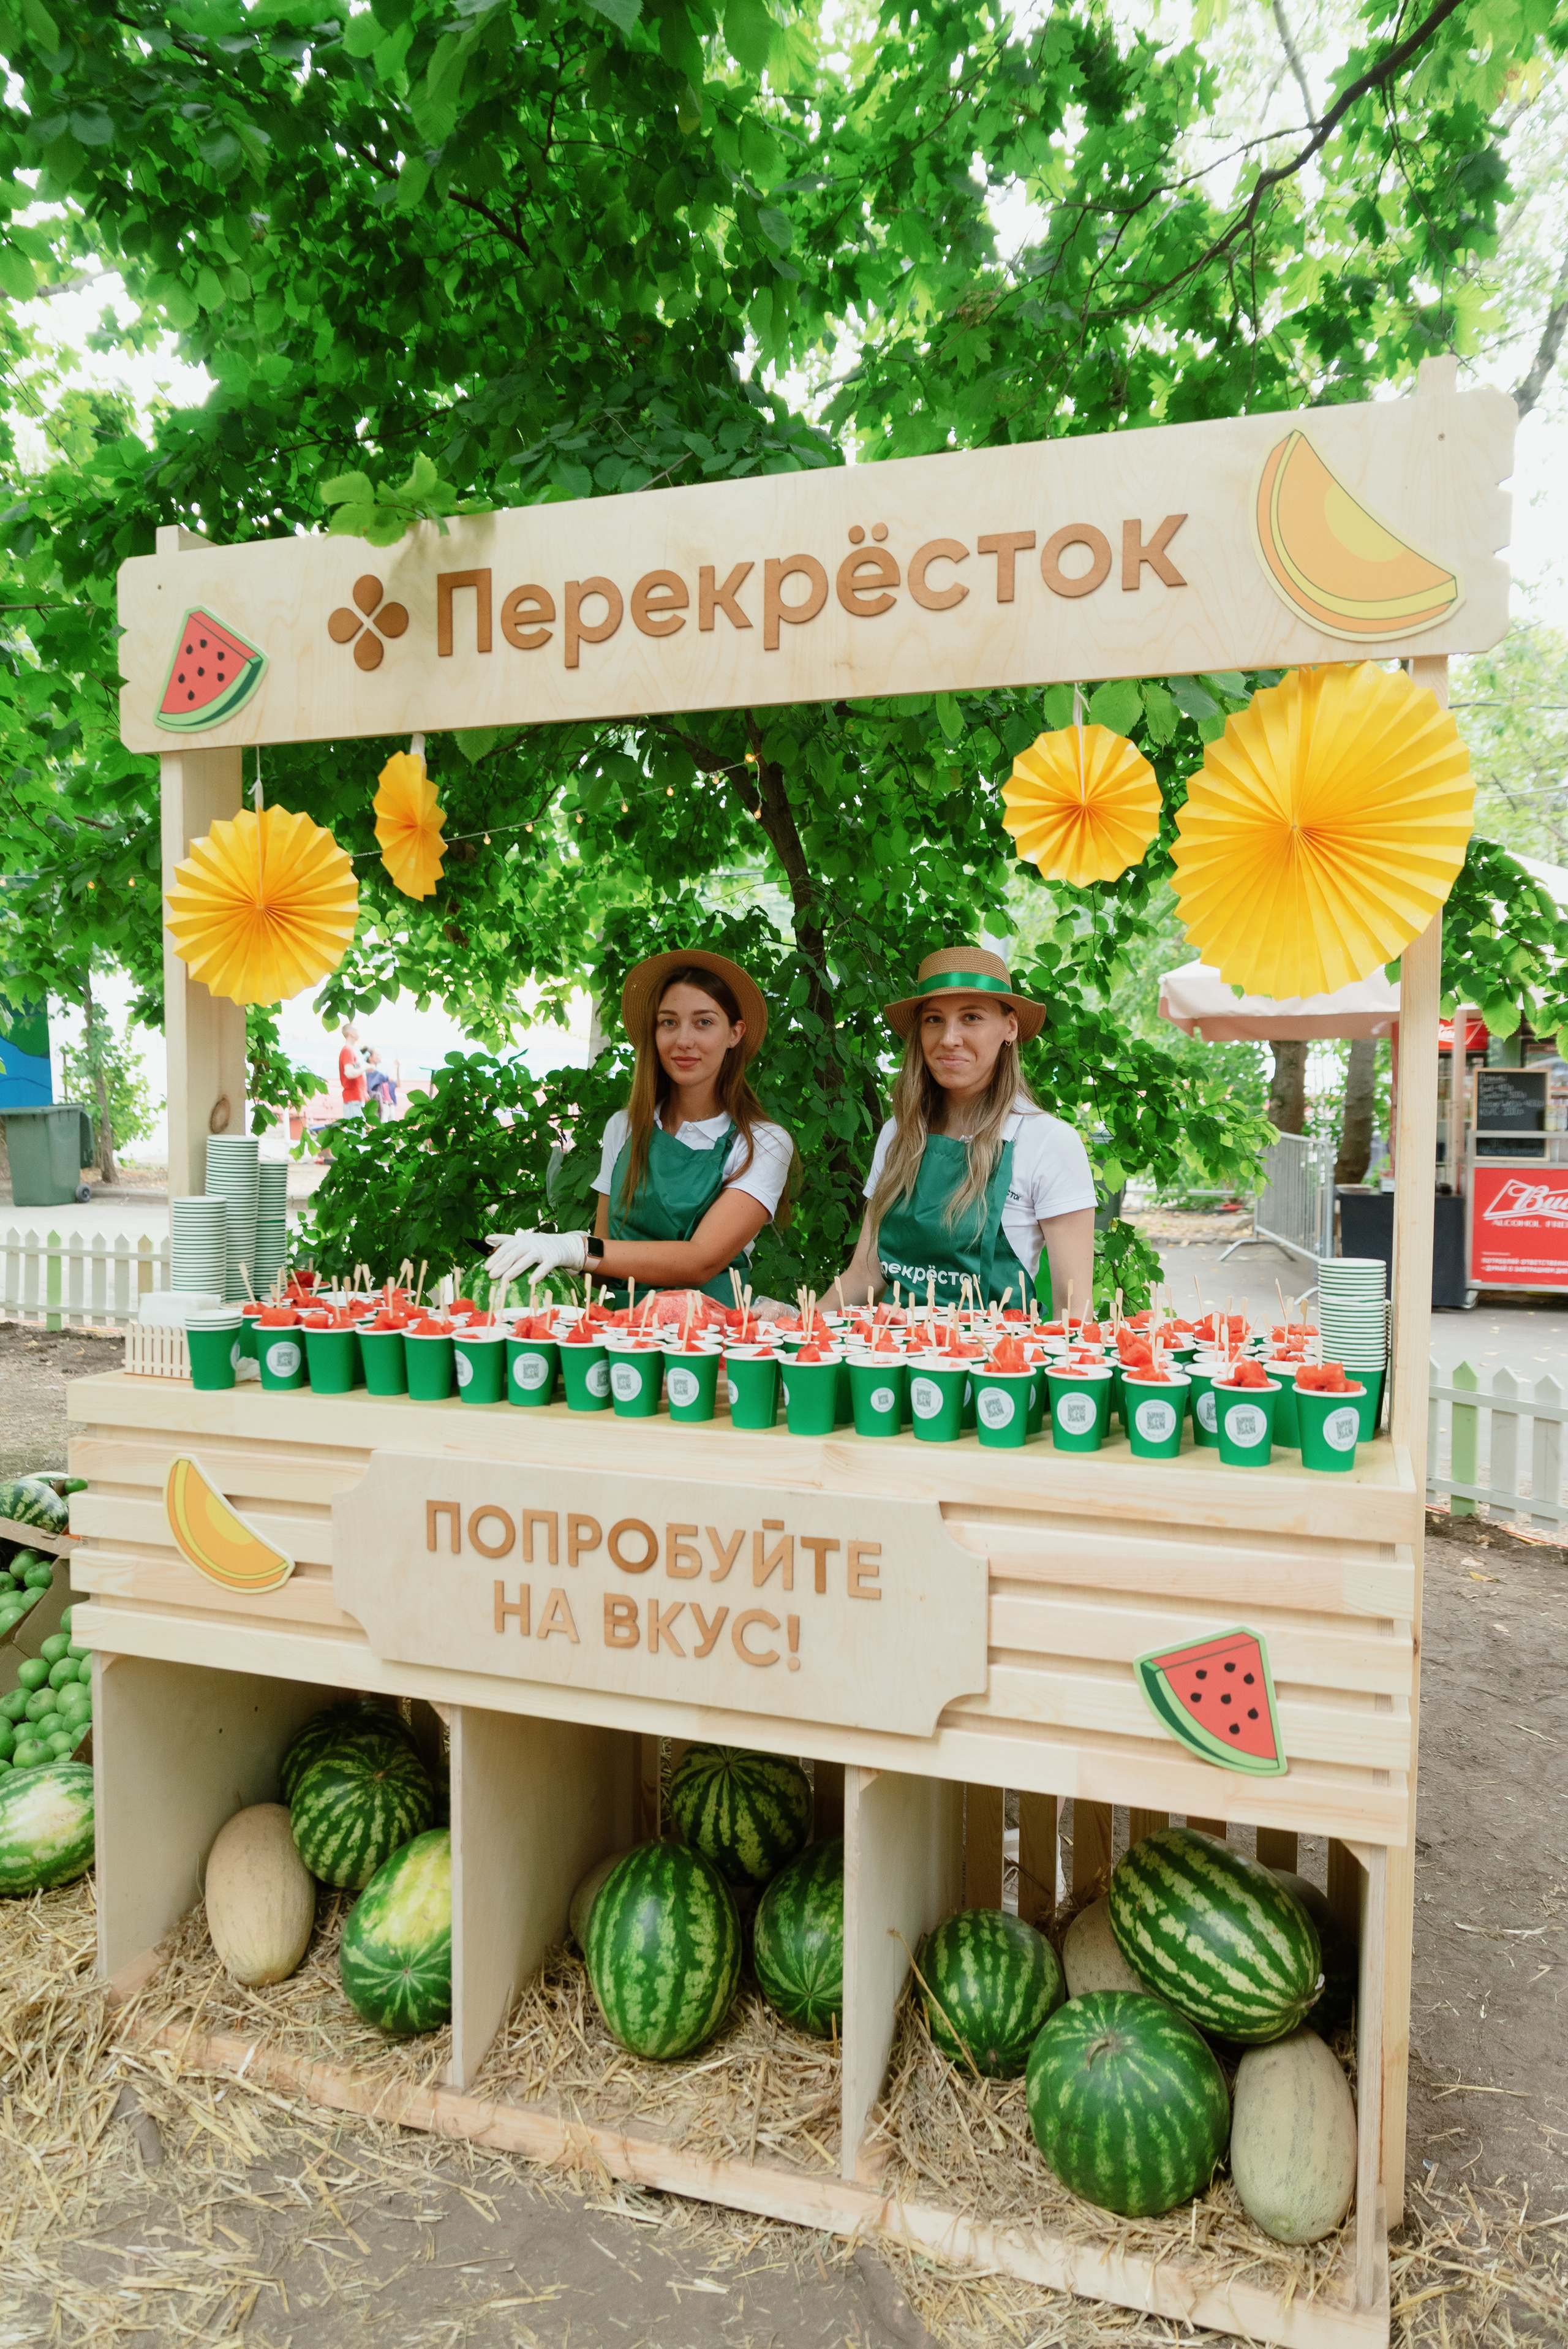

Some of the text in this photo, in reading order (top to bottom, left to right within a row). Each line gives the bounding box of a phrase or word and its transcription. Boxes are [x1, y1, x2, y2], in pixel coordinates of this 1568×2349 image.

[437, 512, 1188, 669] Перекрёсток
[426, 1499, 882, 1600] ПОПРОБУЙТЕ
[493, 1579, 801, 1672] НА ВКУС!
